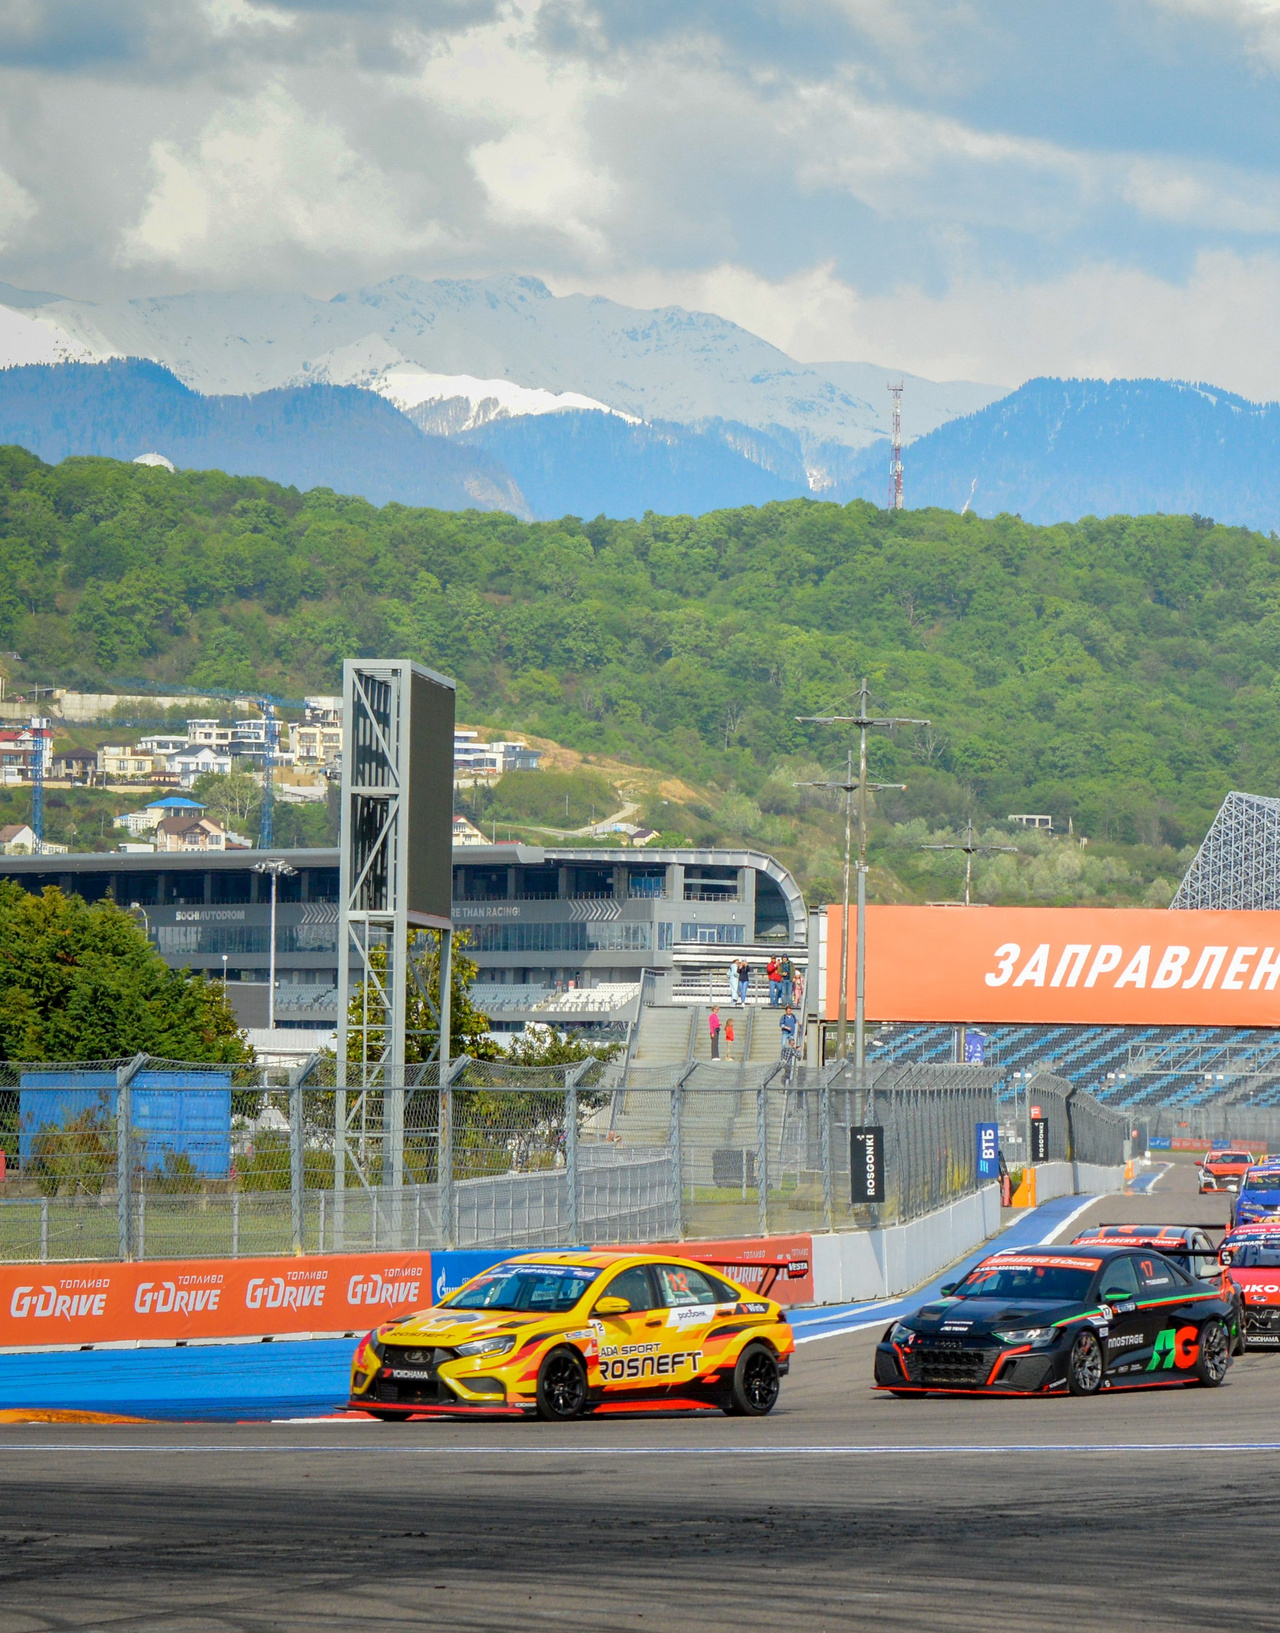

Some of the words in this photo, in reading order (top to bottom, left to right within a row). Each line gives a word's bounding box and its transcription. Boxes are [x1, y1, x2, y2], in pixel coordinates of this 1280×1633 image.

[462, 908, 484, 917] THAN
[486, 907, 521, 917] RACING!
[982, 1129, 995, 1160] ВТБ
[865, 1134, 876, 1196] ROSGONKI
[987, 1256, 1048, 1265] ЗАПРАВЛЕНО
[788, 1262, 808, 1271] VESTA
[1140, 1261, 1153, 1277] 17
[287, 1271, 328, 1280] ТОПЛИВО
[384, 1267, 423, 1277] ТОПЛИВО
[178, 1275, 224, 1285] ТОПЛИВО
[668, 1273, 689, 1291] 12
[966, 1271, 998, 1285] 17
[60, 1279, 110, 1289] ТОПЛИВО
[390, 1331, 455, 1340] ROSNEFT
[600, 1346, 618, 1357] ADA
[621, 1343, 661, 1355] SPORT
[600, 1351, 702, 1380] ROSNEFT
[393, 1369, 428, 1379] YOKOHAMA
